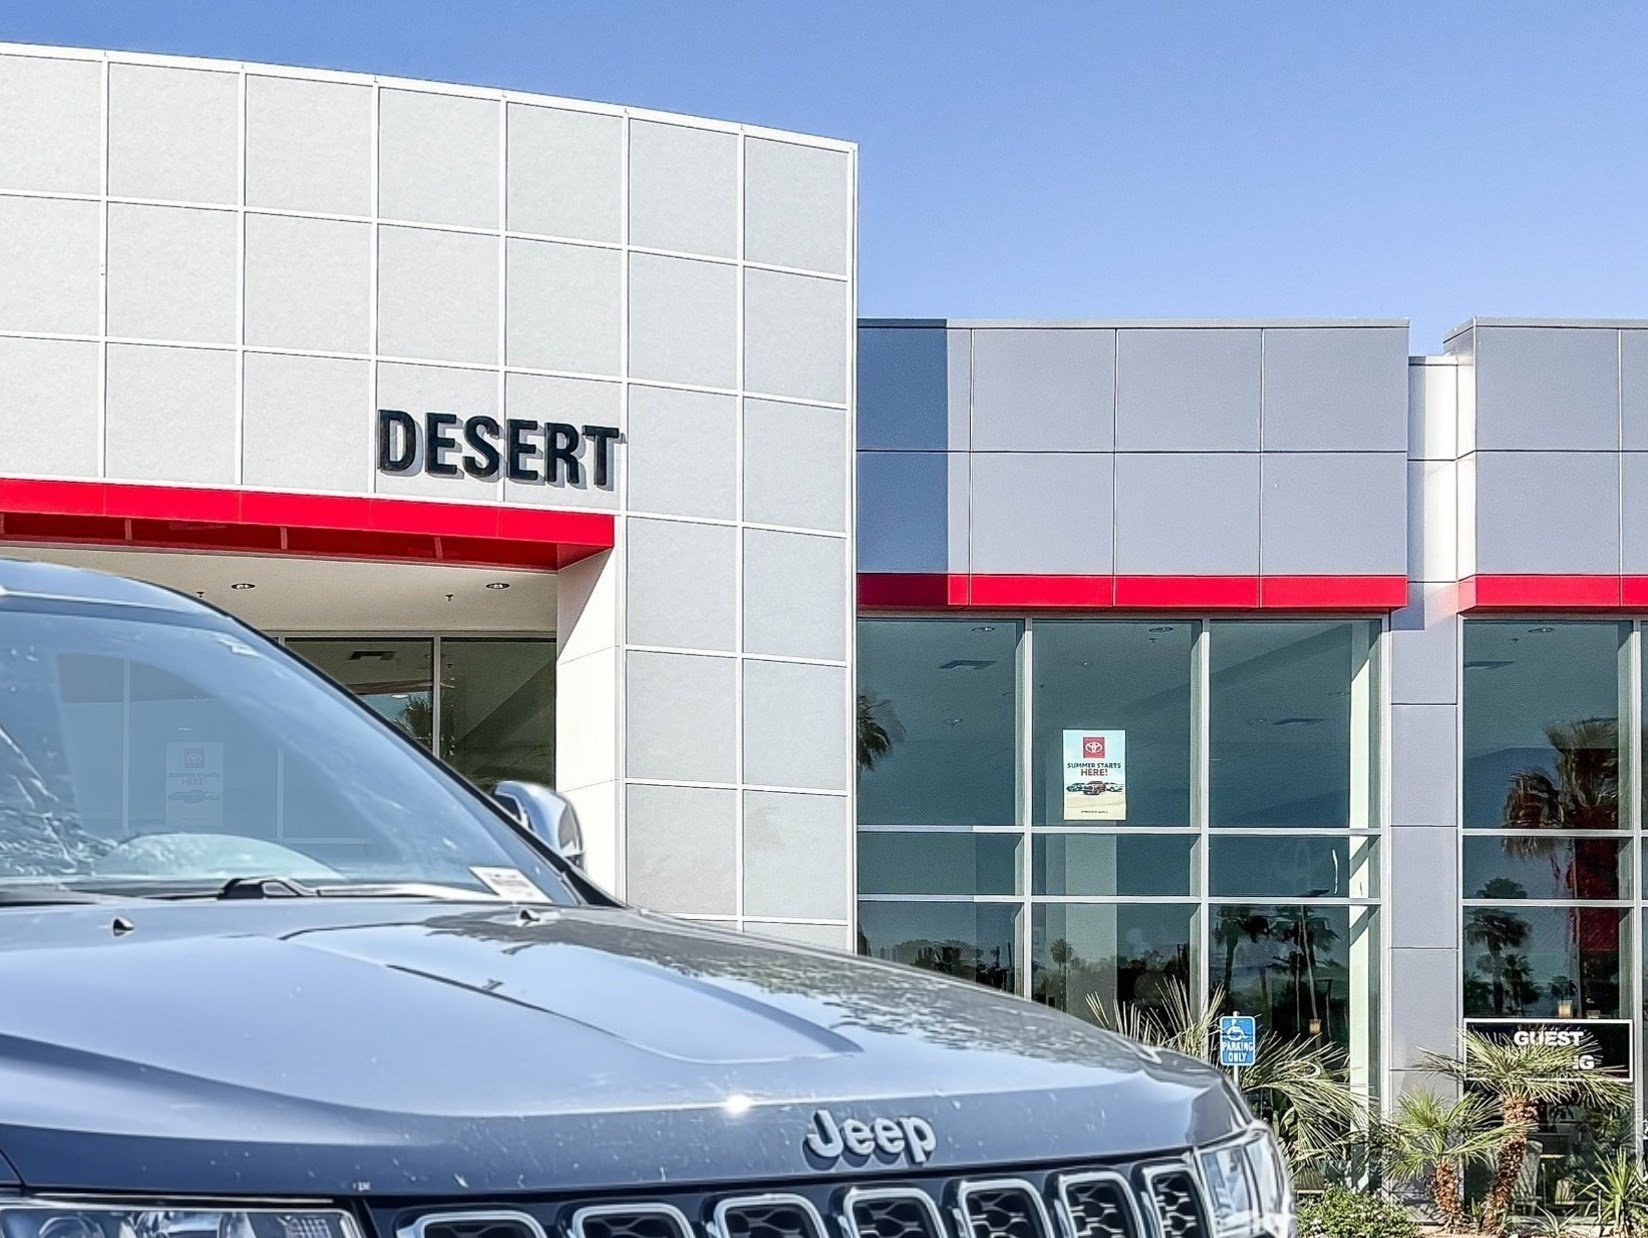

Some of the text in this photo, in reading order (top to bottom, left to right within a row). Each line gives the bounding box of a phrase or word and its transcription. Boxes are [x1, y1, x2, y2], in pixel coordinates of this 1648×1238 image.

[377, 409, 620, 486] DESERT
[1222, 1041, 1254, 1051] PARKING
[1513, 1031, 1584, 1046] GUEST
[1228, 1052, 1247, 1062] ONLY
[806, 1110, 936, 1163] Jeep
